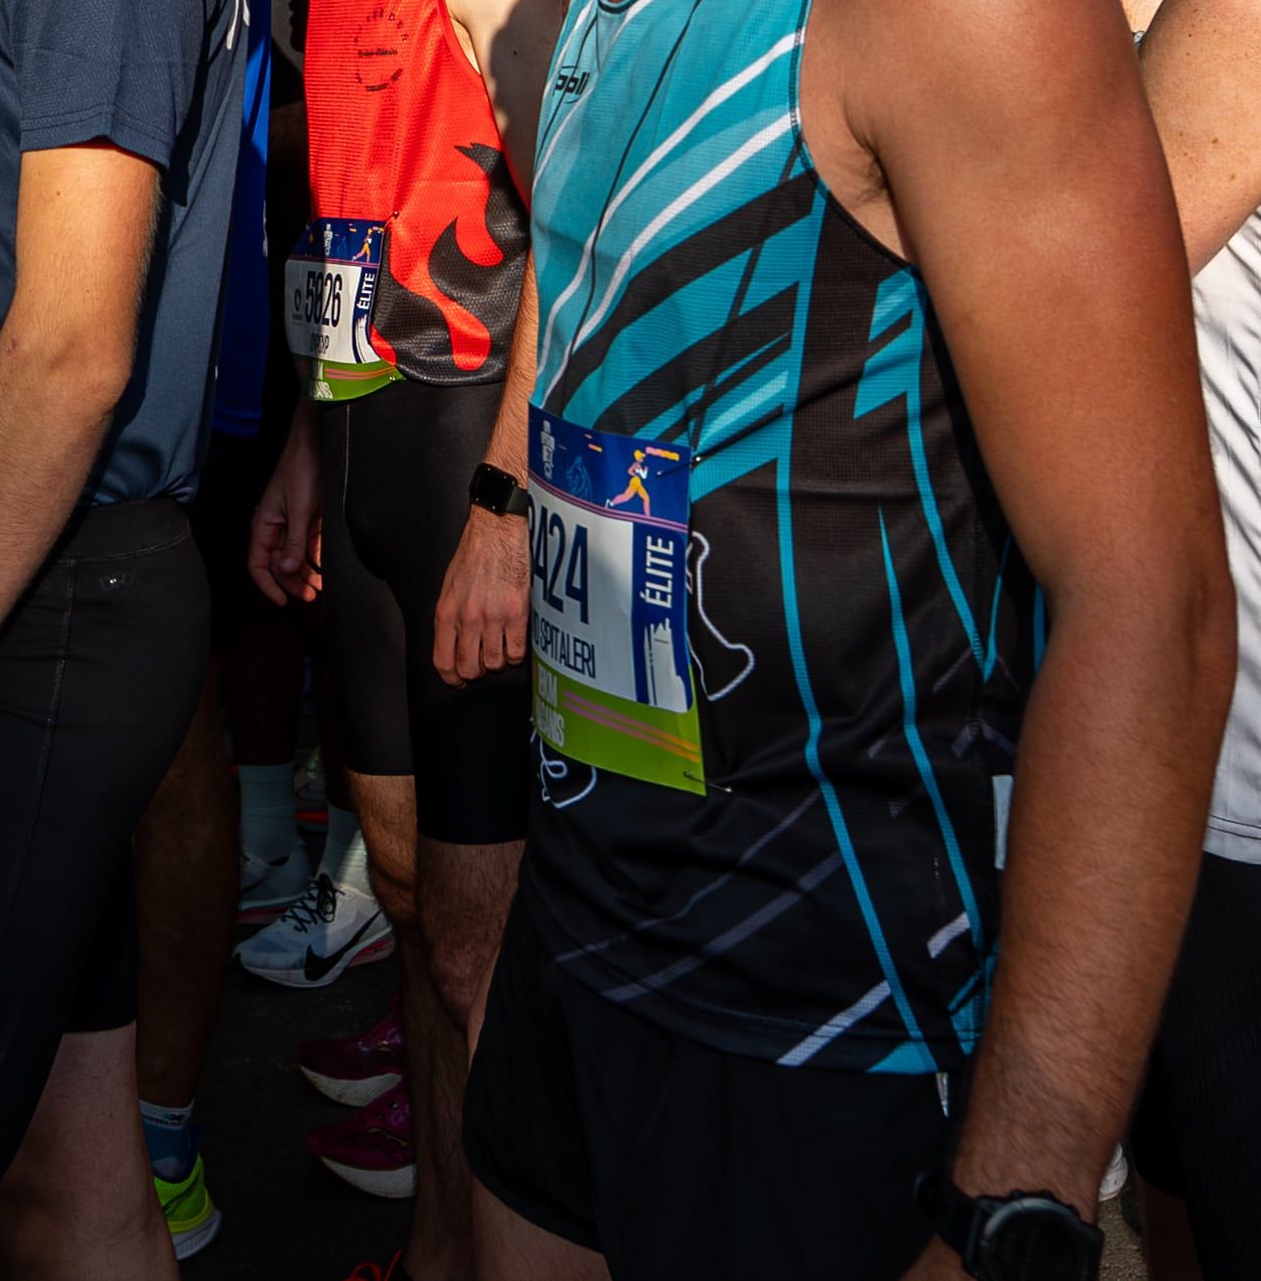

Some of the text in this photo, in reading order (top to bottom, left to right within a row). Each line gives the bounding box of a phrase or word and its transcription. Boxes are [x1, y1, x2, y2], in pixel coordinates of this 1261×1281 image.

[305, 270, 343, 328] 5826
[357, 272, 376, 310] ÉLITE
[640, 535, 675, 609] ÉLITE
[541, 617, 596, 680] SPITALERI
